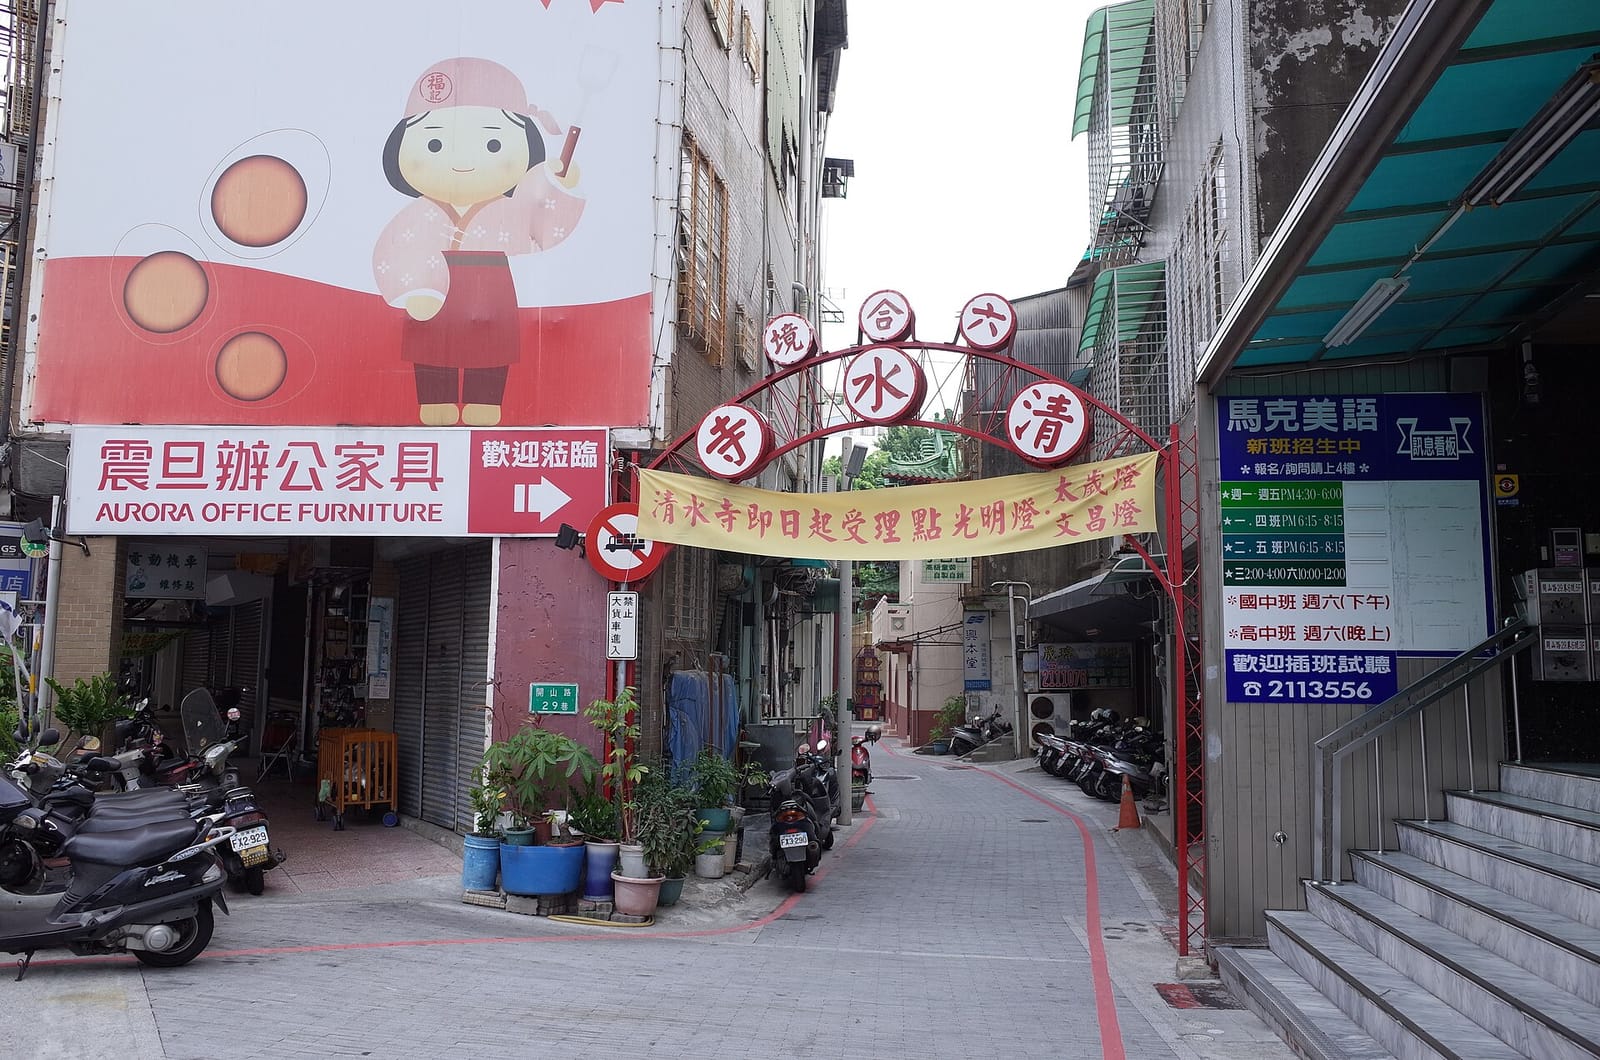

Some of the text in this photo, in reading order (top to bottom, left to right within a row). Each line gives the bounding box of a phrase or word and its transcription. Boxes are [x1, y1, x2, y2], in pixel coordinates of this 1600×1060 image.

[427, 75, 446, 101] 福記
[1226, 397, 1378, 432] 馬克美語
[481, 439, 599, 470] 歡迎蒞臨
[1246, 438, 1361, 455] 新班招生中
[1412, 436, 1457, 457] 訊息看板
[97, 439, 444, 493] 震旦辦公家具
[1053, 462, 1140, 504] 太歲燈
[95, 502, 443, 523] AURORA OFFICE FURNITURE
[1055, 499, 1140, 538] 文昌燈
[129, 551, 199, 569] 電動機車
[623, 596, 634, 619] 禁止
[1239, 594, 1297, 610] 國中班
[610, 596, 622, 656] 大貨車進入
[1239, 625, 1297, 642] 高中班
[1232, 653, 1392, 675] 歡迎插班試聽
[535, 687, 572, 698] 開山路
[1268, 680, 1373, 698] 2113556
[232, 831, 267, 848] FX2-929
